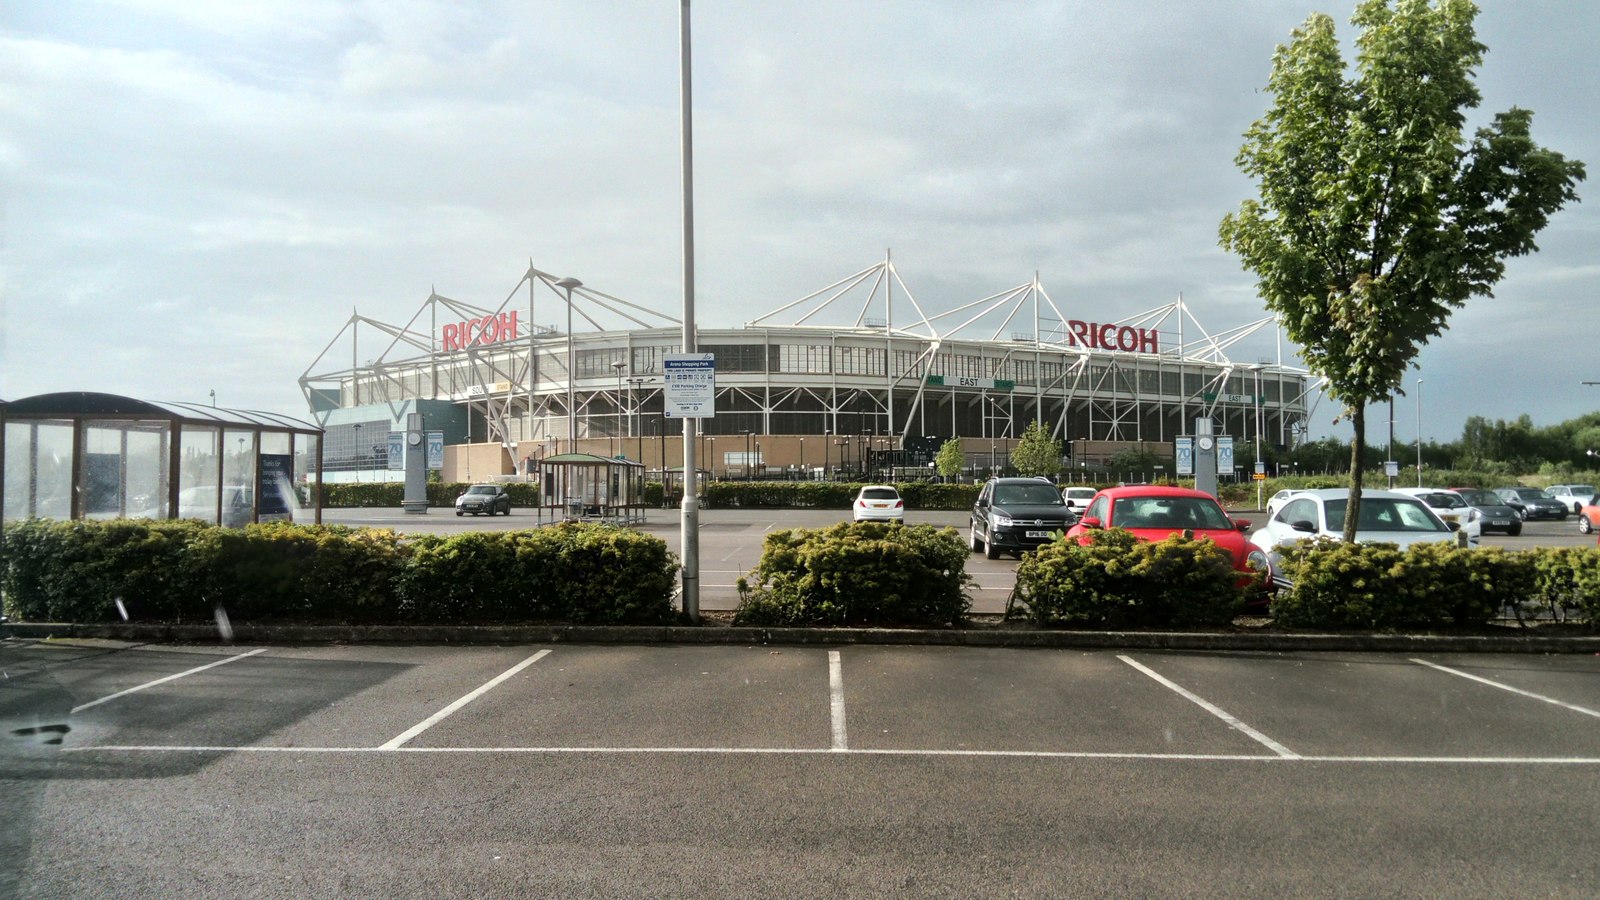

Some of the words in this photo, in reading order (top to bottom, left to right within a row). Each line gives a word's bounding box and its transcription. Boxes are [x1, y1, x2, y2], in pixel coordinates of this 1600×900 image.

[443, 311, 517, 352] RICOH
[1068, 320, 1158, 354] RICOH
[960, 378, 979, 387] EAST
[389, 443, 402, 452] 70
[430, 442, 442, 452] 70
[1177, 448, 1191, 458] 70
[1218, 448, 1232, 458] 70
